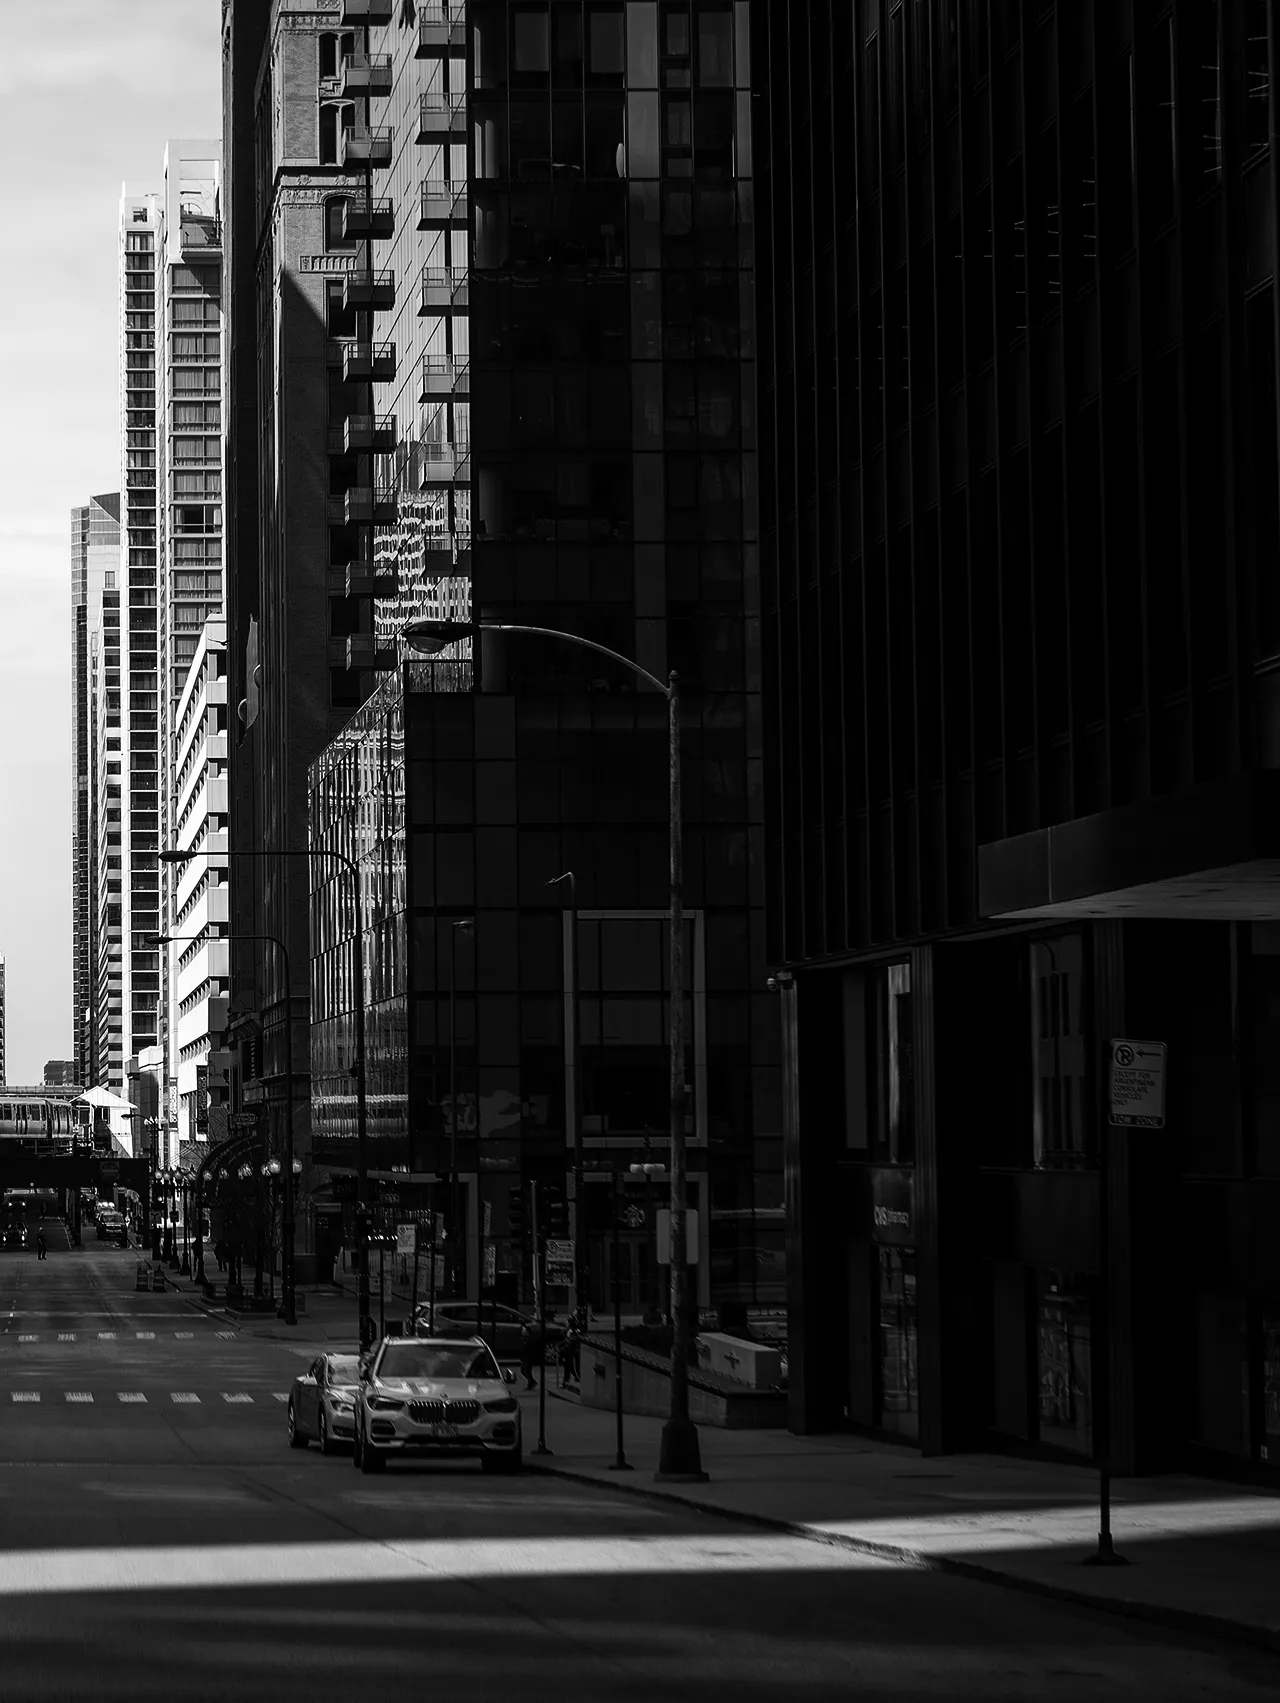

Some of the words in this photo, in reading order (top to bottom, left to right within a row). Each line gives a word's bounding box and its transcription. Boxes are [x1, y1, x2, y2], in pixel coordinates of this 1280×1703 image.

[1113, 1114, 1132, 1125] TOW
[1135, 1115, 1162, 1127] ZONE
[874, 1205, 888, 1226] CVS
